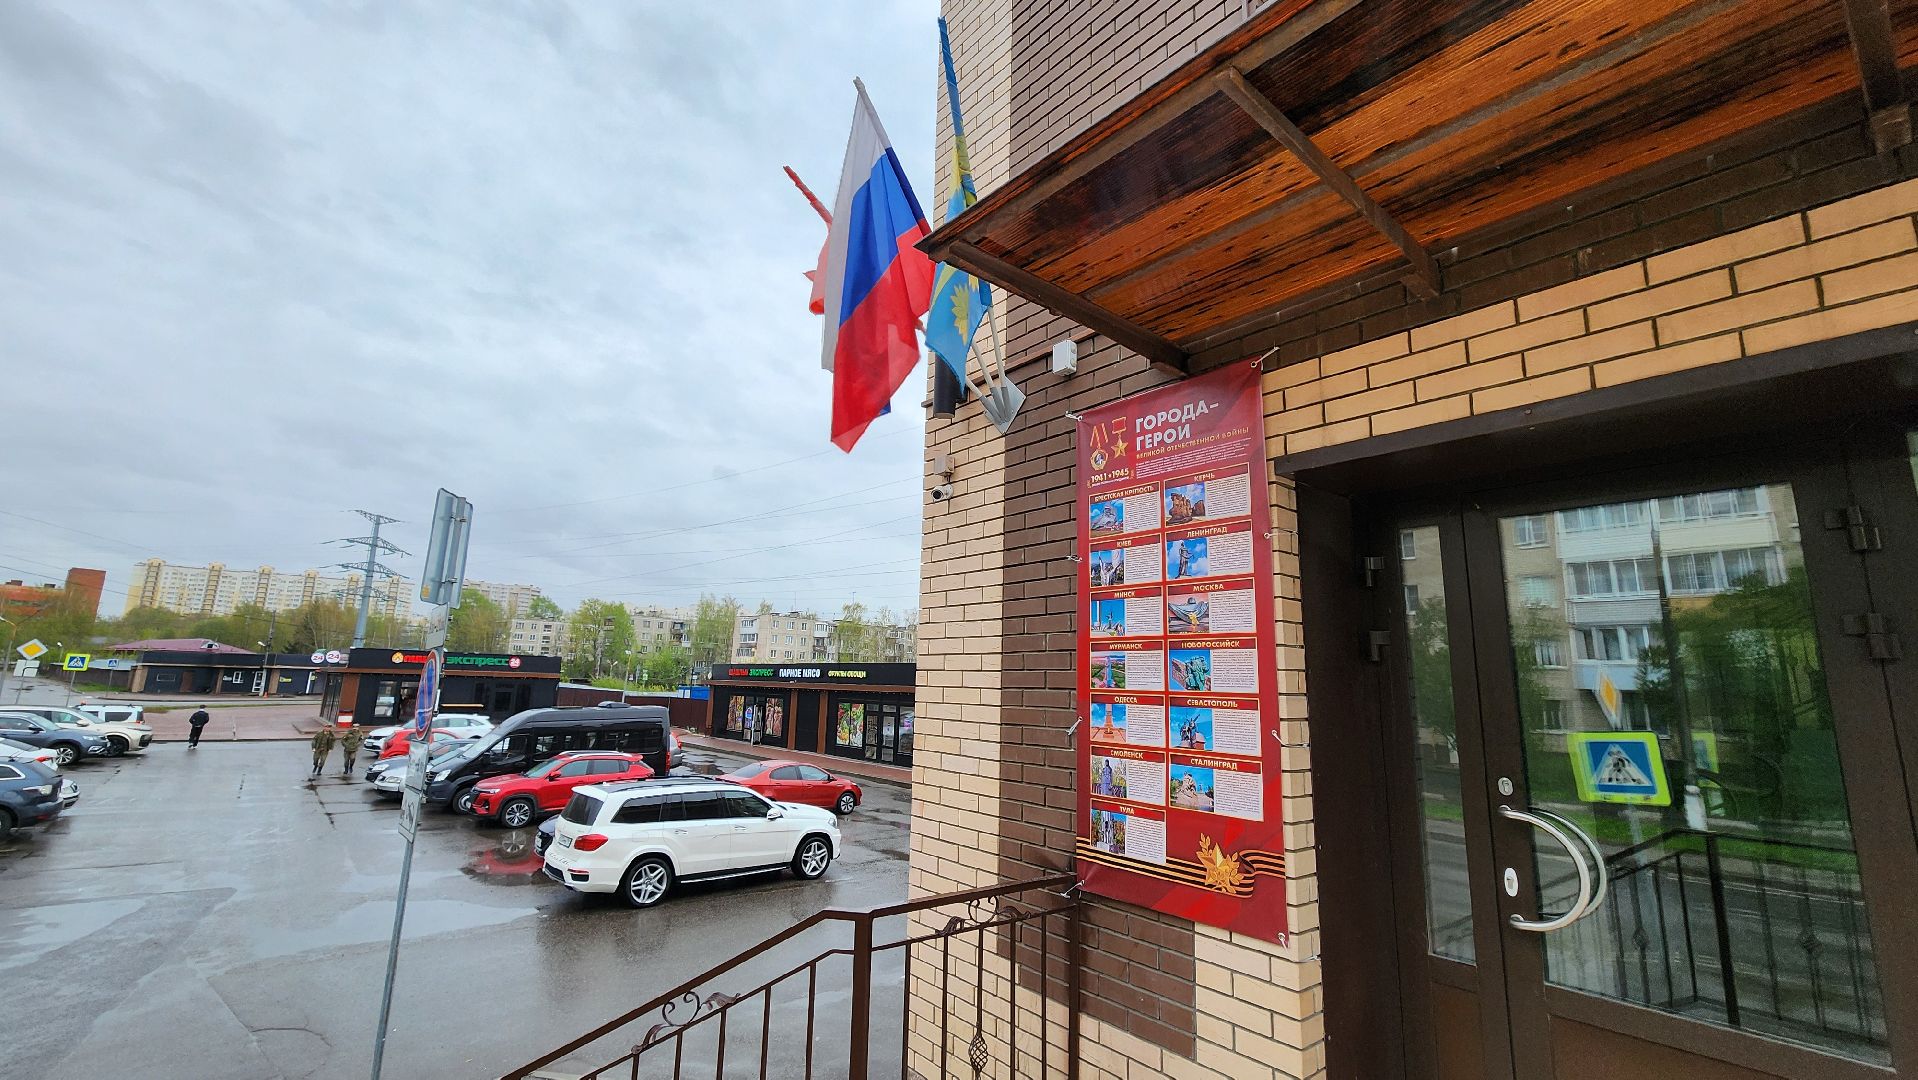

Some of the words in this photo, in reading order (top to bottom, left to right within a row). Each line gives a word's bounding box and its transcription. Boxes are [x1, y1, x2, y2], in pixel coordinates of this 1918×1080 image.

[1136, 424, 1191, 451] ГЕРОИ
[1136, 446, 1165, 460] ВЕЛИКОЙ
[1166, 435, 1220, 453] ОТЕЧЕСТВЕННОЙ
[1222, 426, 1249, 440] ВОЙНЫ
[1090, 472, 1107, 484] 1941
[1112, 468, 1130, 479] 1945
[1193, 472, 1216, 482] КЕРЧЬ
[1094, 490, 1124, 503] БРЕСТСКАЯ
[1186, 526, 1228, 538] ЛЕНИНГРАД
[1116, 540, 1132, 548] КИЕВ
[1192, 583, 1225, 592] МОСКВА
[1113, 591, 1136, 599] МИНСК
[1181, 639, 1240, 649] НОВОРОССИЙСК
[779, 668, 802, 678] ПАРНОЕ
[802, 668, 821, 678] МЯСО
[1114, 696, 1138, 704] ОДЕССА
[1186, 698, 1238, 708] СЕВАСТОПОЛЬ
[1110, 749, 1143, 759] СМОЛЕНСК
[1190, 757, 1238, 771] СТАЛИНГРАД
[1118, 805, 1135, 815] ТУЛА
